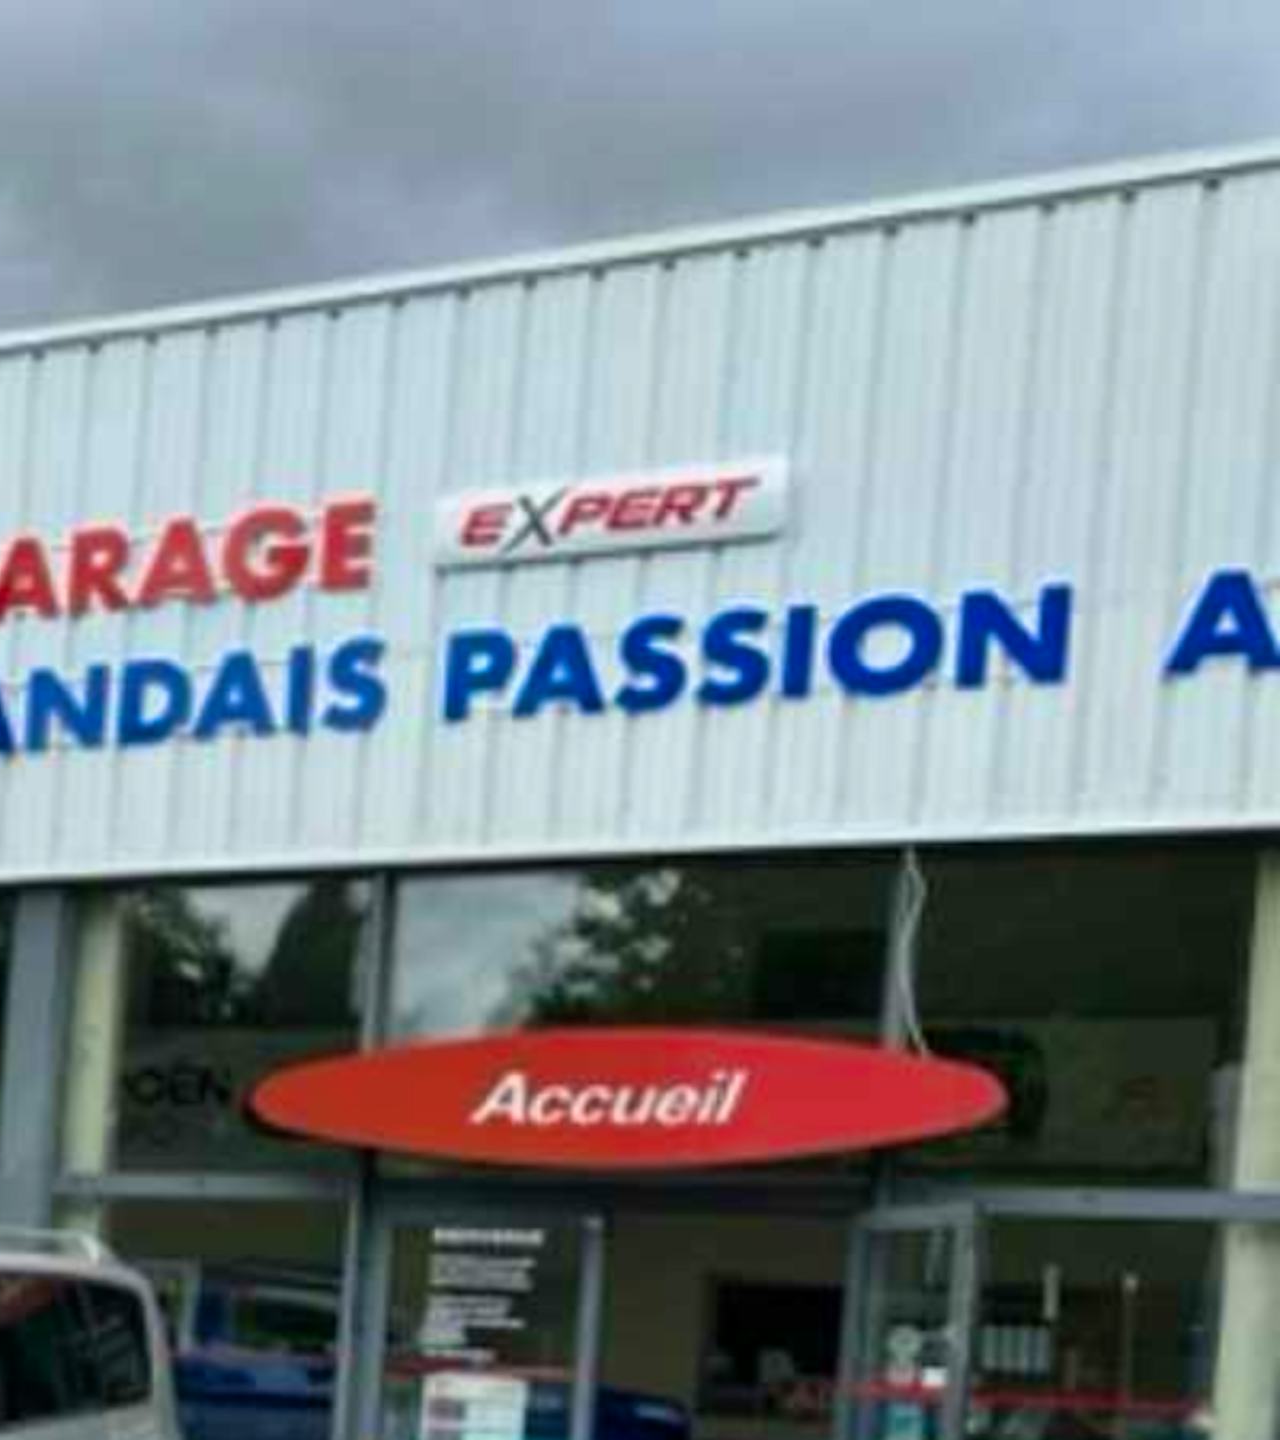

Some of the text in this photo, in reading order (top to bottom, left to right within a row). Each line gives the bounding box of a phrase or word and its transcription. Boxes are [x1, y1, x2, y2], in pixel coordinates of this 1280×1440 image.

[460, 475, 761, 551] EXPERT
[444, 583, 1073, 722] PASSION
[470, 1069, 748, 1126] Accueil
